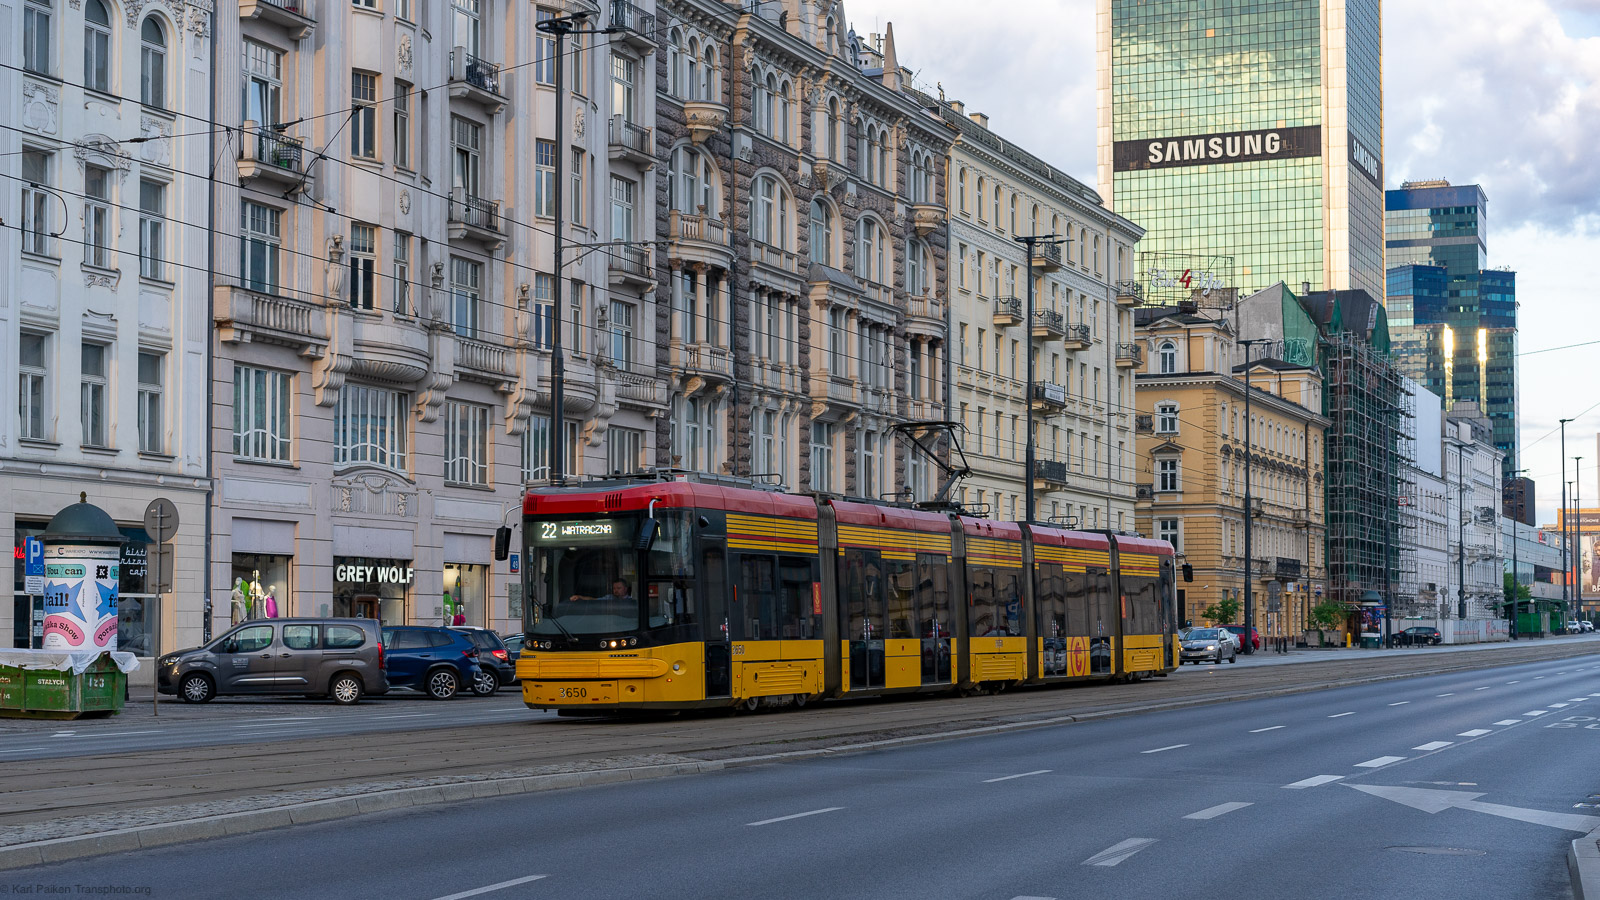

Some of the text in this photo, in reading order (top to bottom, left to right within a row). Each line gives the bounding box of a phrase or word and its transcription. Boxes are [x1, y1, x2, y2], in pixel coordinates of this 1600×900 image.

[1148, 132, 1280, 163] SAMSUNG
[1353, 139, 1378, 180] SAMSUNG
[541, 523, 612, 539] 22 WIATRACZNA
[30, 540, 41, 564] P
[47, 566, 83, 575] You can
[336, 565, 414, 584] GREY WOLF
[45, 592, 69, 607] fail!
[59, 622, 79, 640] Show
[37, 678, 65, 686] STAŁYCH
[559, 687, 587, 698] 3650
